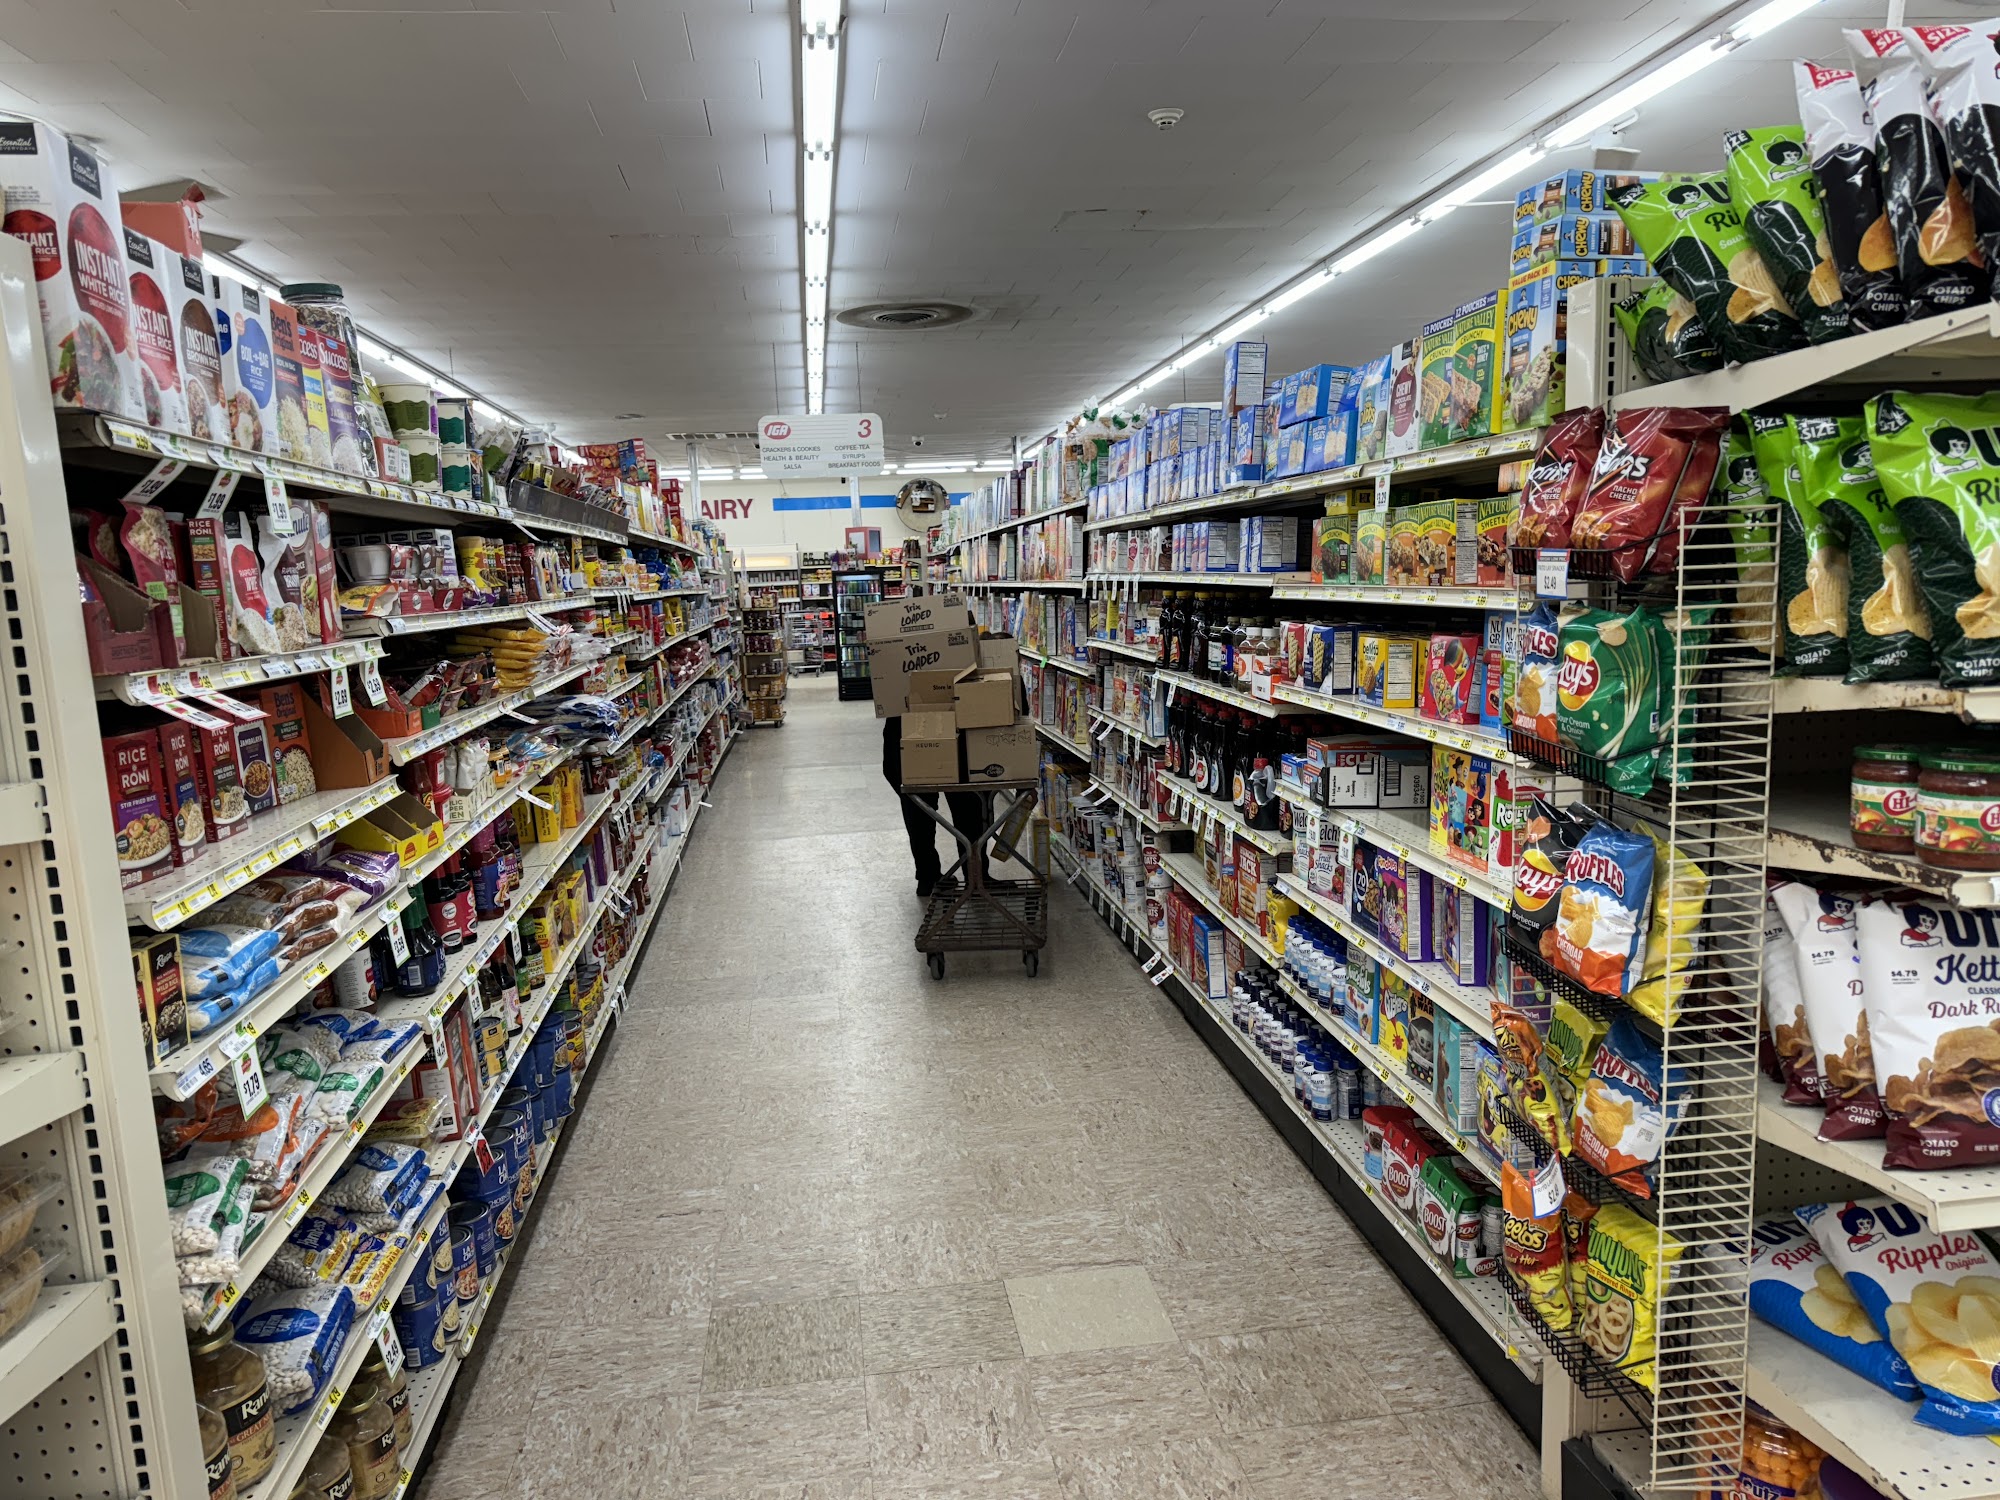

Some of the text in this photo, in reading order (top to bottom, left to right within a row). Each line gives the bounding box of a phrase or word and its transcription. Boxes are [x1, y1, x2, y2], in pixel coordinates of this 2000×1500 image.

[1926, 26, 1964, 45] SIZE
[1816, 69, 1850, 84] SIZE
[73, 156, 98, 183] Essential
[1580, 171, 1595, 212] CHEWY
[1516, 200, 1536, 221] CHEWY
[1575, 216, 1590, 257] CHEWY
[1512, 243, 1532, 264] CHEWY
[75, 239, 120, 288] INSTANT
[1512, 276, 1527, 287] VALUE
[1528, 271, 1541, 282] PACK
[78, 271, 126, 306] WHITE RICE
[1927, 285, 1975, 295] POTATO
[1455, 296, 1487, 319] 12 POUCHES
[1871, 302, 1900, 312] CHIPS
[1933, 295, 1966, 305] CHIPS
[132, 304, 170, 339] NSTANT
[270, 309, 293, 338] Ben's
[1430, 317, 1453, 334] POUCHES
[1455, 308, 1494, 338] NATURE VALLEY
[1508, 305, 1538, 337] CHEWY
[158, 338, 172, 351] RICE
[185, 326, 217, 357] INSTANT
[1460, 330, 1484, 345] CRUNCHY
[299, 339, 317, 360] ccess
[319, 342, 348, 371] Success
[1430, 348, 1452, 361] CRUNCHY
[187, 350, 219, 369] BROWN RICE
[251, 367, 263, 376] RICE
[1396, 380, 1411, 396] CHEWY
[767, 425, 788, 436] IGA
[857, 419, 871, 438] 3
[1754, 418, 1784, 431] SIZE
[1800, 425, 1837, 440] SIZE
[1609, 491, 1636, 502] CHEESE
[1613, 484, 1638, 494] NACHO
[272, 502, 287, 520] $1.99
[700, 499, 753, 520] AIRY
[1436, 503, 1453, 517] VALLEY
[1479, 500, 1509, 518] NATUR
[1481, 518, 1499, 530] SWEET
[903, 602, 921, 613] Trix
[901, 609, 932, 627] LOADED
[904, 642, 927, 656] Trix
[902, 651, 940, 673] LOADED
[1558, 656, 1595, 695] Lay's
[1961, 668, 1994, 678] CHIPS
[273, 690, 294, 708] Ben's
[276, 703, 296, 718] Original
[1557, 713, 1590, 729] Sour Cream
[1567, 726, 1585, 736] Onion
[170, 735, 186, 750] RICE
[239, 734, 263, 747] JAMBALAYA
[118, 747, 147, 765] RICE
[213, 742, 230, 757] RONI
[1885, 753, 1908, 761] MILD
[174, 755, 190, 772] RONI
[1472, 759, 1487, 770] PIXAR
[1941, 762, 1965, 771] MILD
[121, 770, 150, 789] RONI
[120, 795, 157, 810] STIR FRIED RICE
[1315, 861, 1333, 872] Snacks
[1318, 853, 1331, 864] Fruit
[1239, 858, 1257, 876] JACK
[1564, 850, 1626, 898] RUFFLES
[1358, 874, 1366, 886] 70
[1457, 876, 1467, 887] 5.19
[1512, 910, 1540, 930] Barbecue
[1556, 936, 1584, 962] CHEDDAR
[1811, 950, 1835, 959] $4.79
[1891, 969, 1918, 979] $4.79
[1934, 953, 2000, 986] Kett
[155, 979, 179, 993] WILD RICE
[1418, 1002, 1434, 1016] WAR
[1928, 999, 1979, 1019] Dark
[199, 1057, 214, 1077] 4.65
[243, 1071, 261, 1098] $1.79
[1405, 1092, 1415, 1104] 5.19
[1844, 1105, 1883, 1118] POTATO
[1848, 1115, 1876, 1126] CHIPS
[1456, 1137, 1467, 1150] 5.19
[1580, 1127, 1610, 1160] CHEDDAR
[1920, 1139, 1959, 1148] POTATO
[1922, 1148, 1952, 1157] CHIPS
[1388, 1166, 1411, 1188] BOOST
[1424, 1207, 1447, 1232] BOOST
[1503, 1211, 1547, 1252] eetos
[1519, 1254, 1539, 1266] Hot
[1588, 1219, 1647, 1294] FUNYUNS
[1771, 1237, 1823, 1271] Ripp
[1878, 1233, 1980, 1275] Ripples
[1475, 1261, 1497, 1273] BOOST
[1945, 1255, 1988, 1271] Original
[1597, 1271, 1636, 1298] Flavored Rings
[385, 1340, 400, 1365] $2.49
[329, 1386, 342, 1405] 4.79
[1935, 1403, 1966, 1419] CHIPS
[236, 1423, 260, 1442] GREAT
